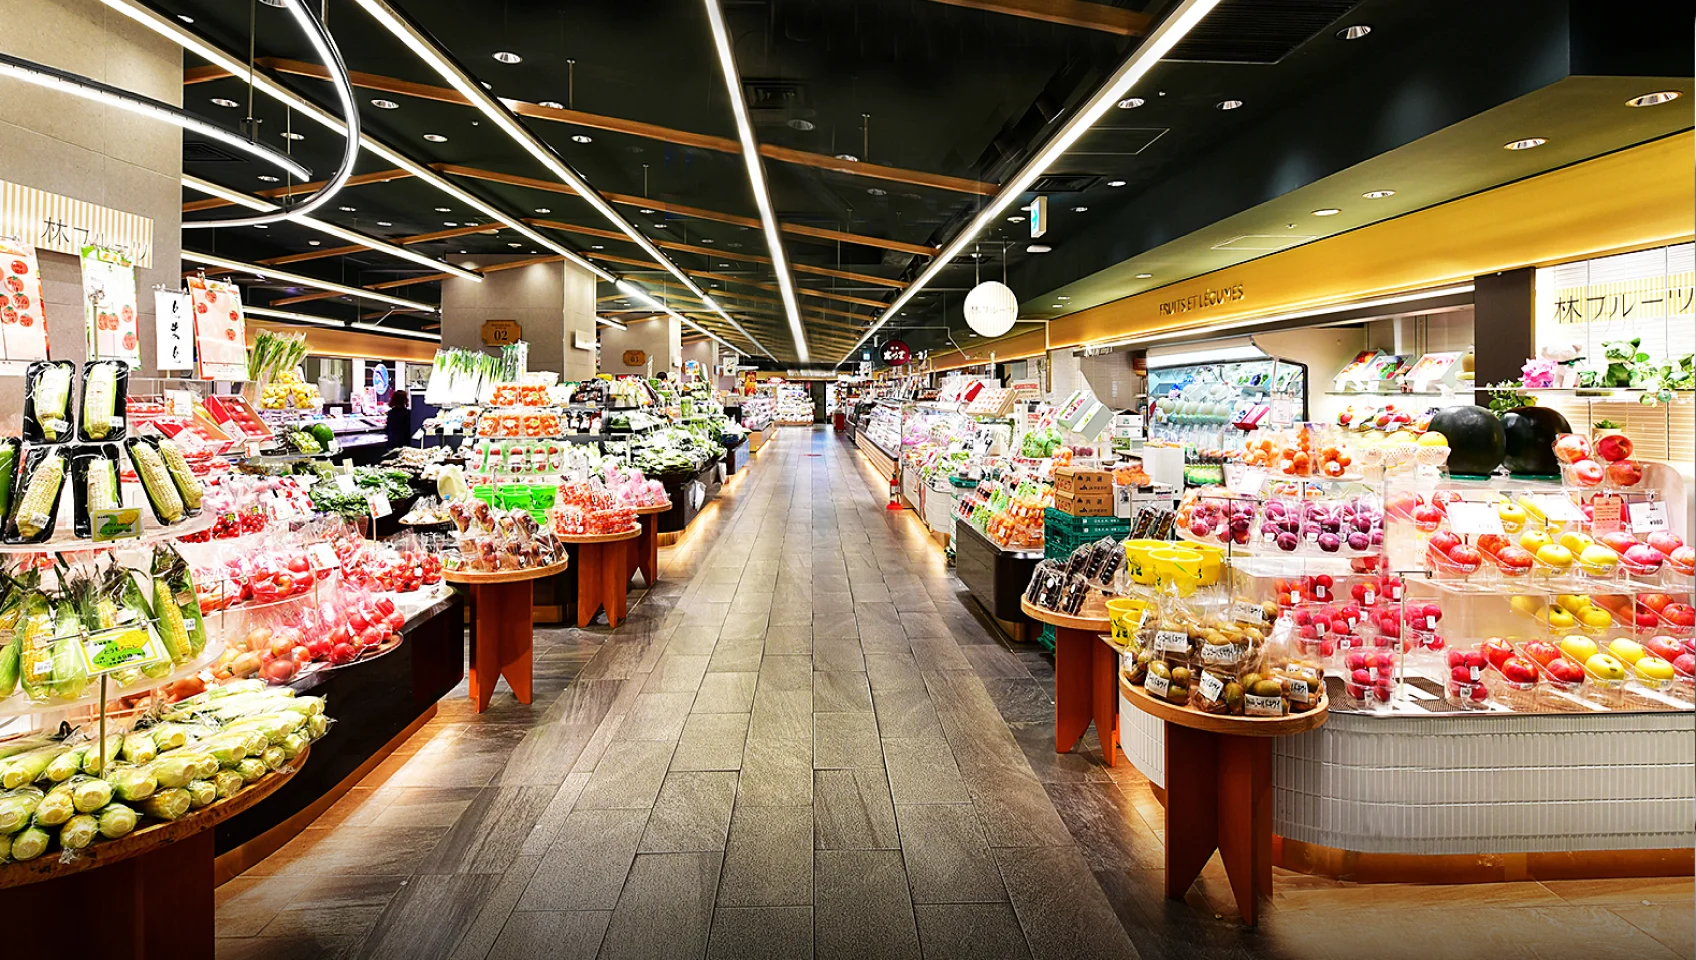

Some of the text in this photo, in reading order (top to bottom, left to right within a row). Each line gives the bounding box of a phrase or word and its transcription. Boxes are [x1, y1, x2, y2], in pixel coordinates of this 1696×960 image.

[1159, 283, 1244, 316] FRUITS ET LÉGUMES
[1552, 287, 1694, 324] 林フルーツ
[494, 330, 508, 341] 02
